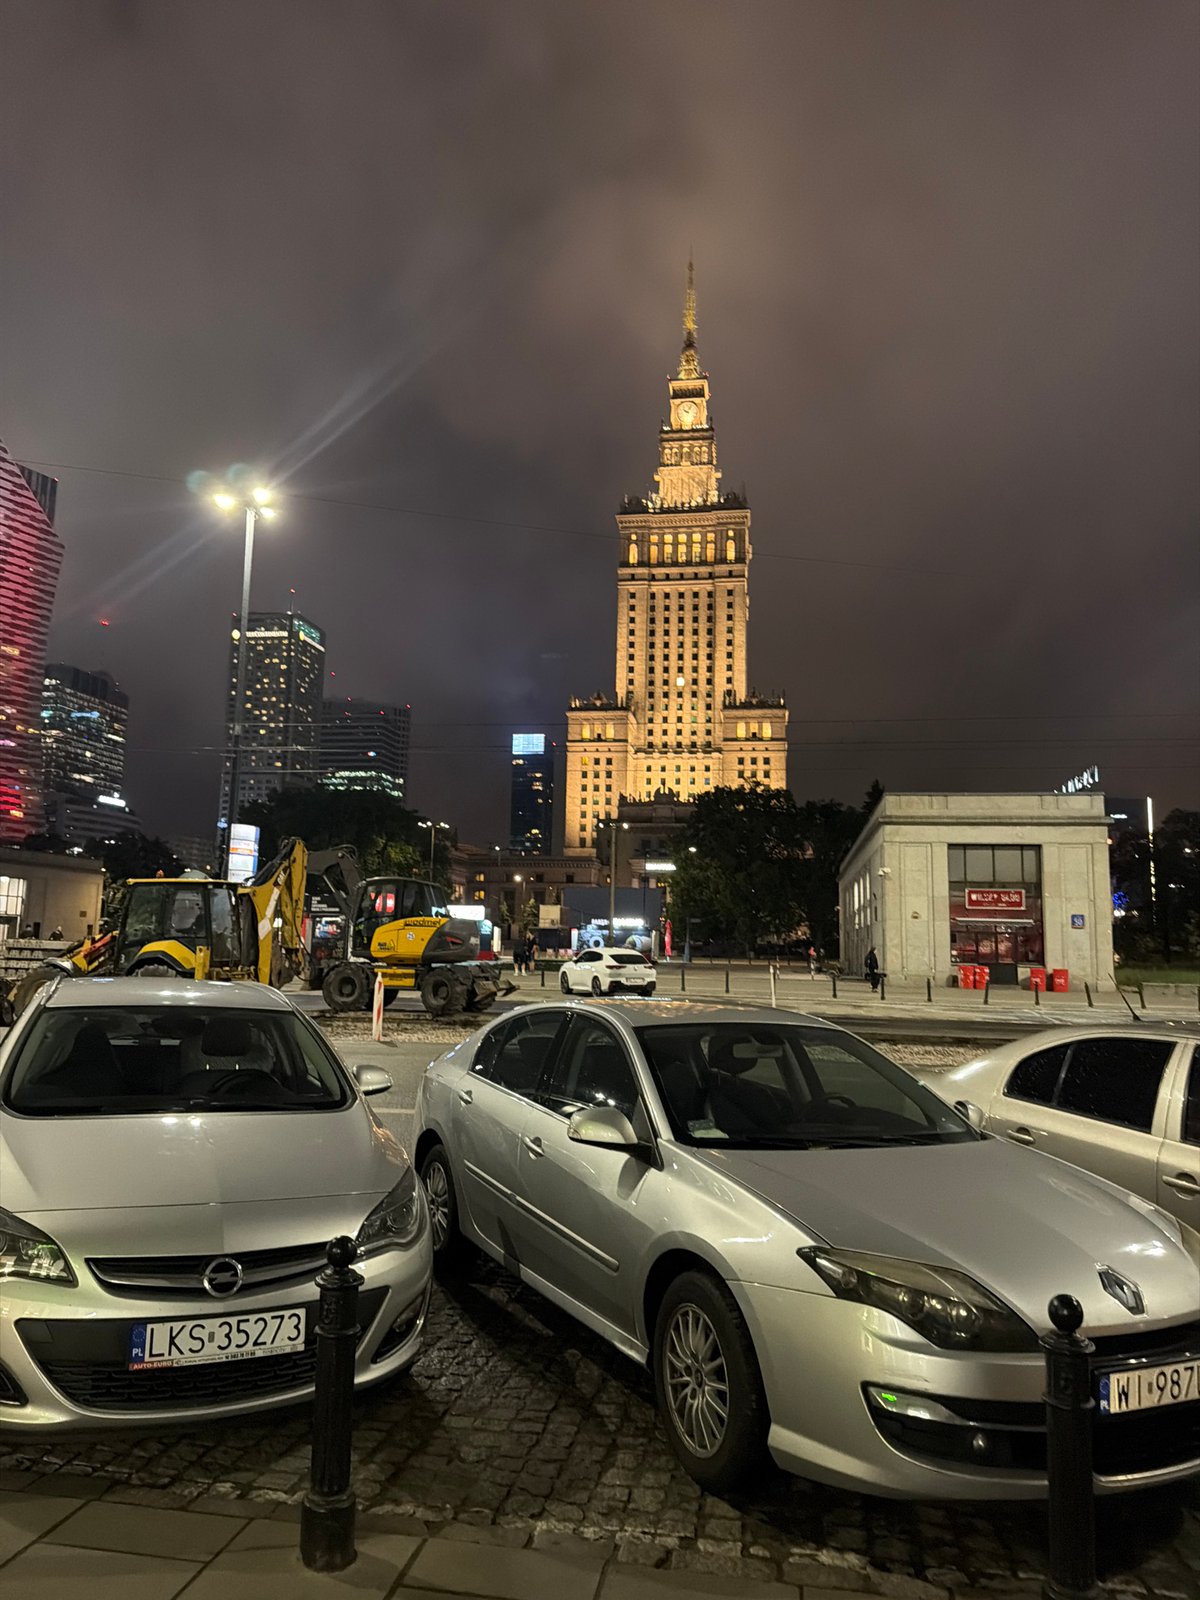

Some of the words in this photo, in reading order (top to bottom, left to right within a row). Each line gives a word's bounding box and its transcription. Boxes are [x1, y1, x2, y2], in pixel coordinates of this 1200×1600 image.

[132, 1347, 144, 1358] PL
[148, 1323, 206, 1359] LKS
[217, 1313, 301, 1351] 35273
[1116, 1374, 1142, 1411] WI
[1155, 1364, 1200, 1403] 987
